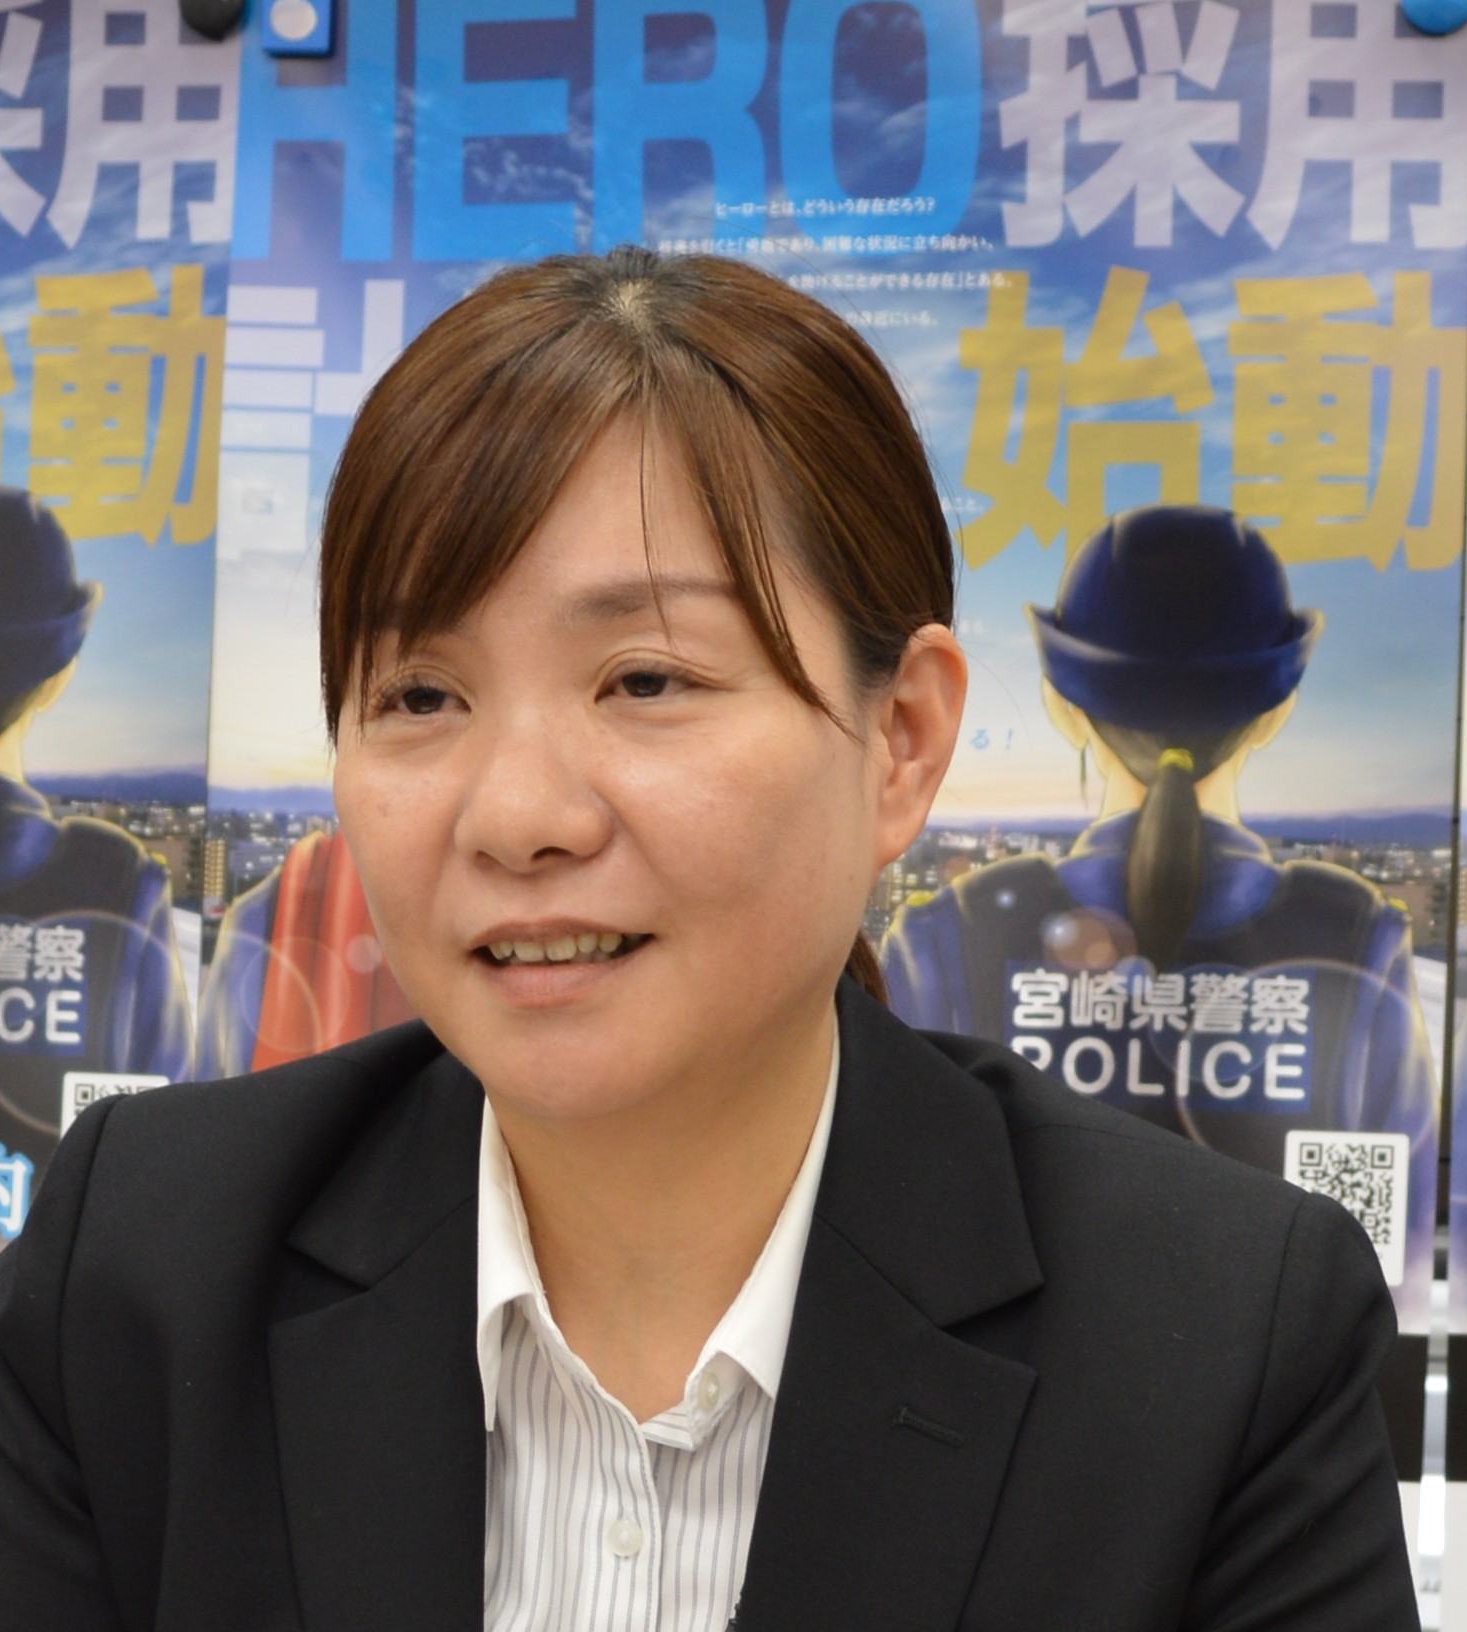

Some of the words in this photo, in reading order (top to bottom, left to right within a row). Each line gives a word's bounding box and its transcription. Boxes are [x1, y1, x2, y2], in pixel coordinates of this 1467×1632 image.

[1010, 969, 1310, 1036] 宮崎県警察
[1010, 1036, 1306, 1101] POLICE
